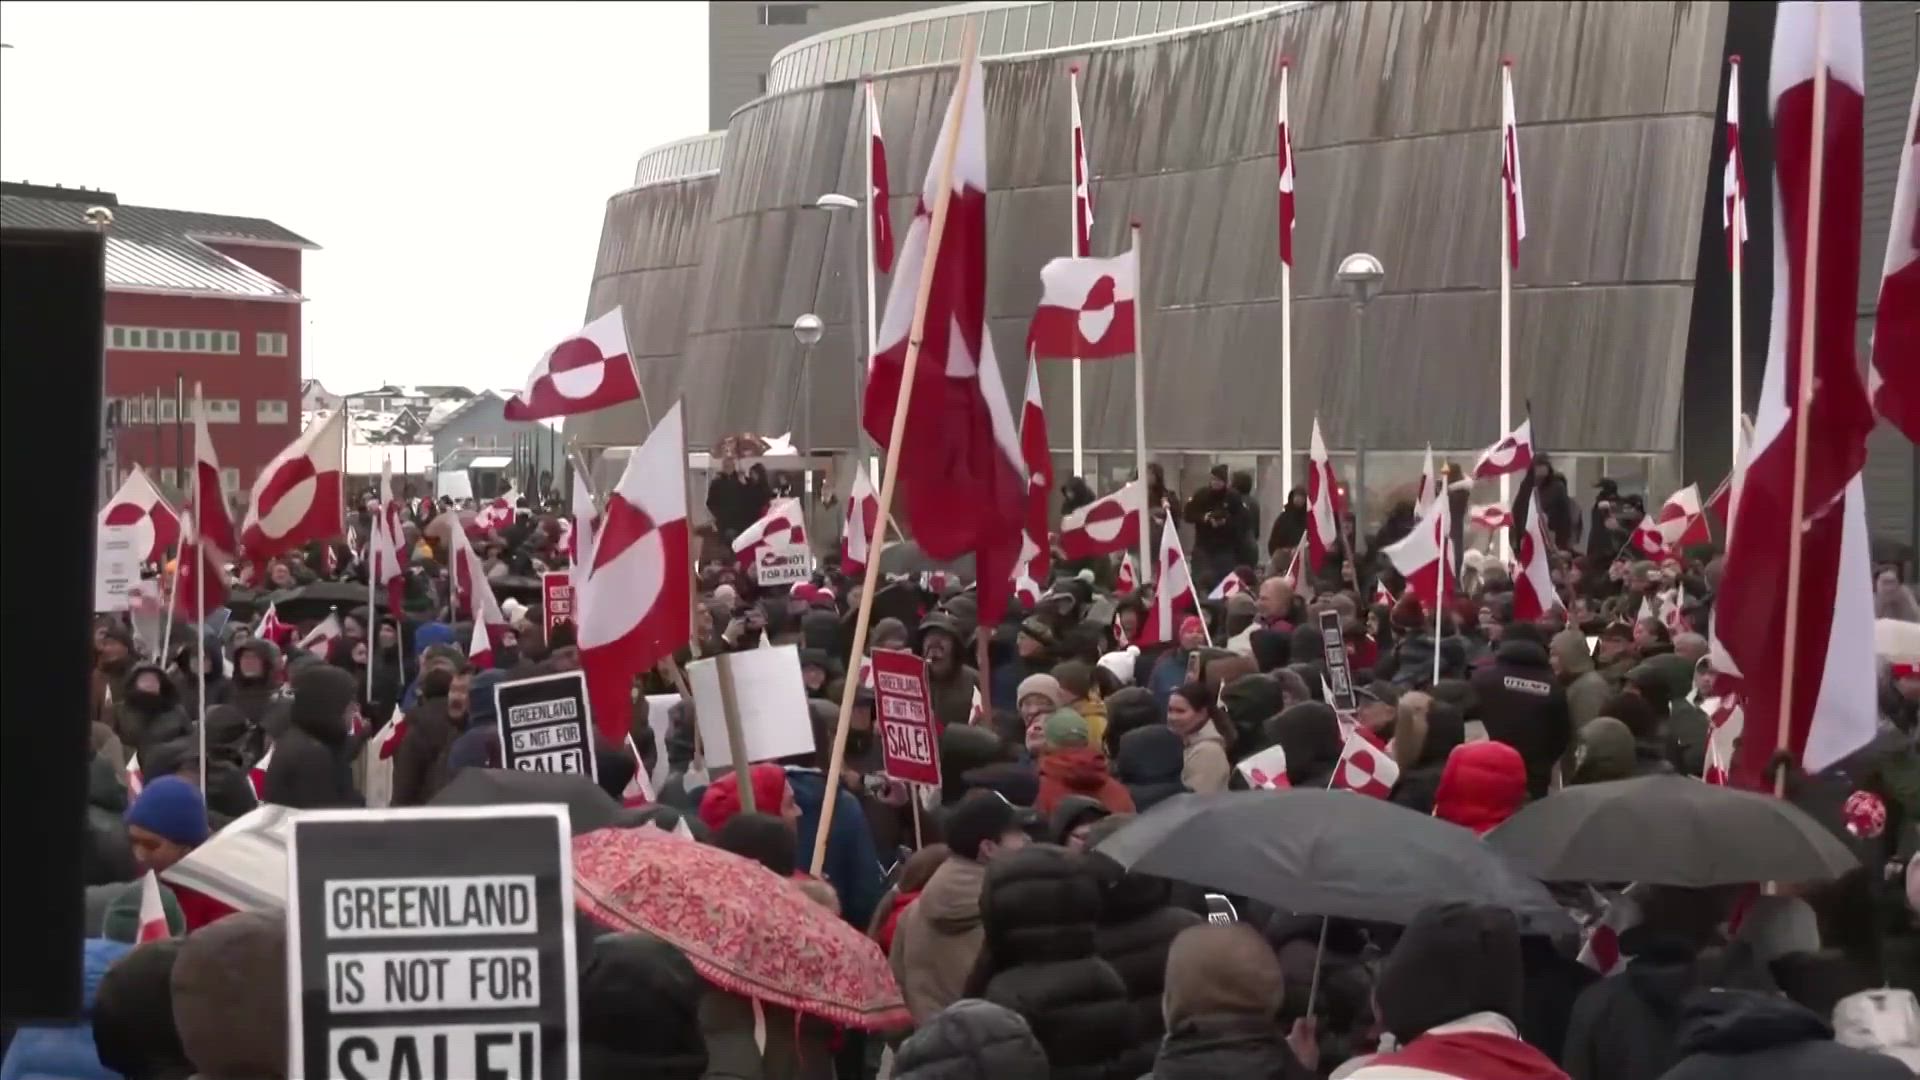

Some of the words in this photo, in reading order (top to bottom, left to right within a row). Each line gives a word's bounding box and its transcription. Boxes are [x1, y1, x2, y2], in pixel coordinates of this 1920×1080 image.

[511, 700, 576, 724] GREENLAND
[514, 735, 524, 749] IS
[530, 730, 551, 746] NOT
[557, 726, 578, 742] FOR
[887, 724, 929, 761] SALE!
[332, 883, 530, 930] GREENLAND
[334, 960, 366, 1004] IS
[384, 958, 451, 1003] NOT
[469, 956, 533, 1001] FOR
